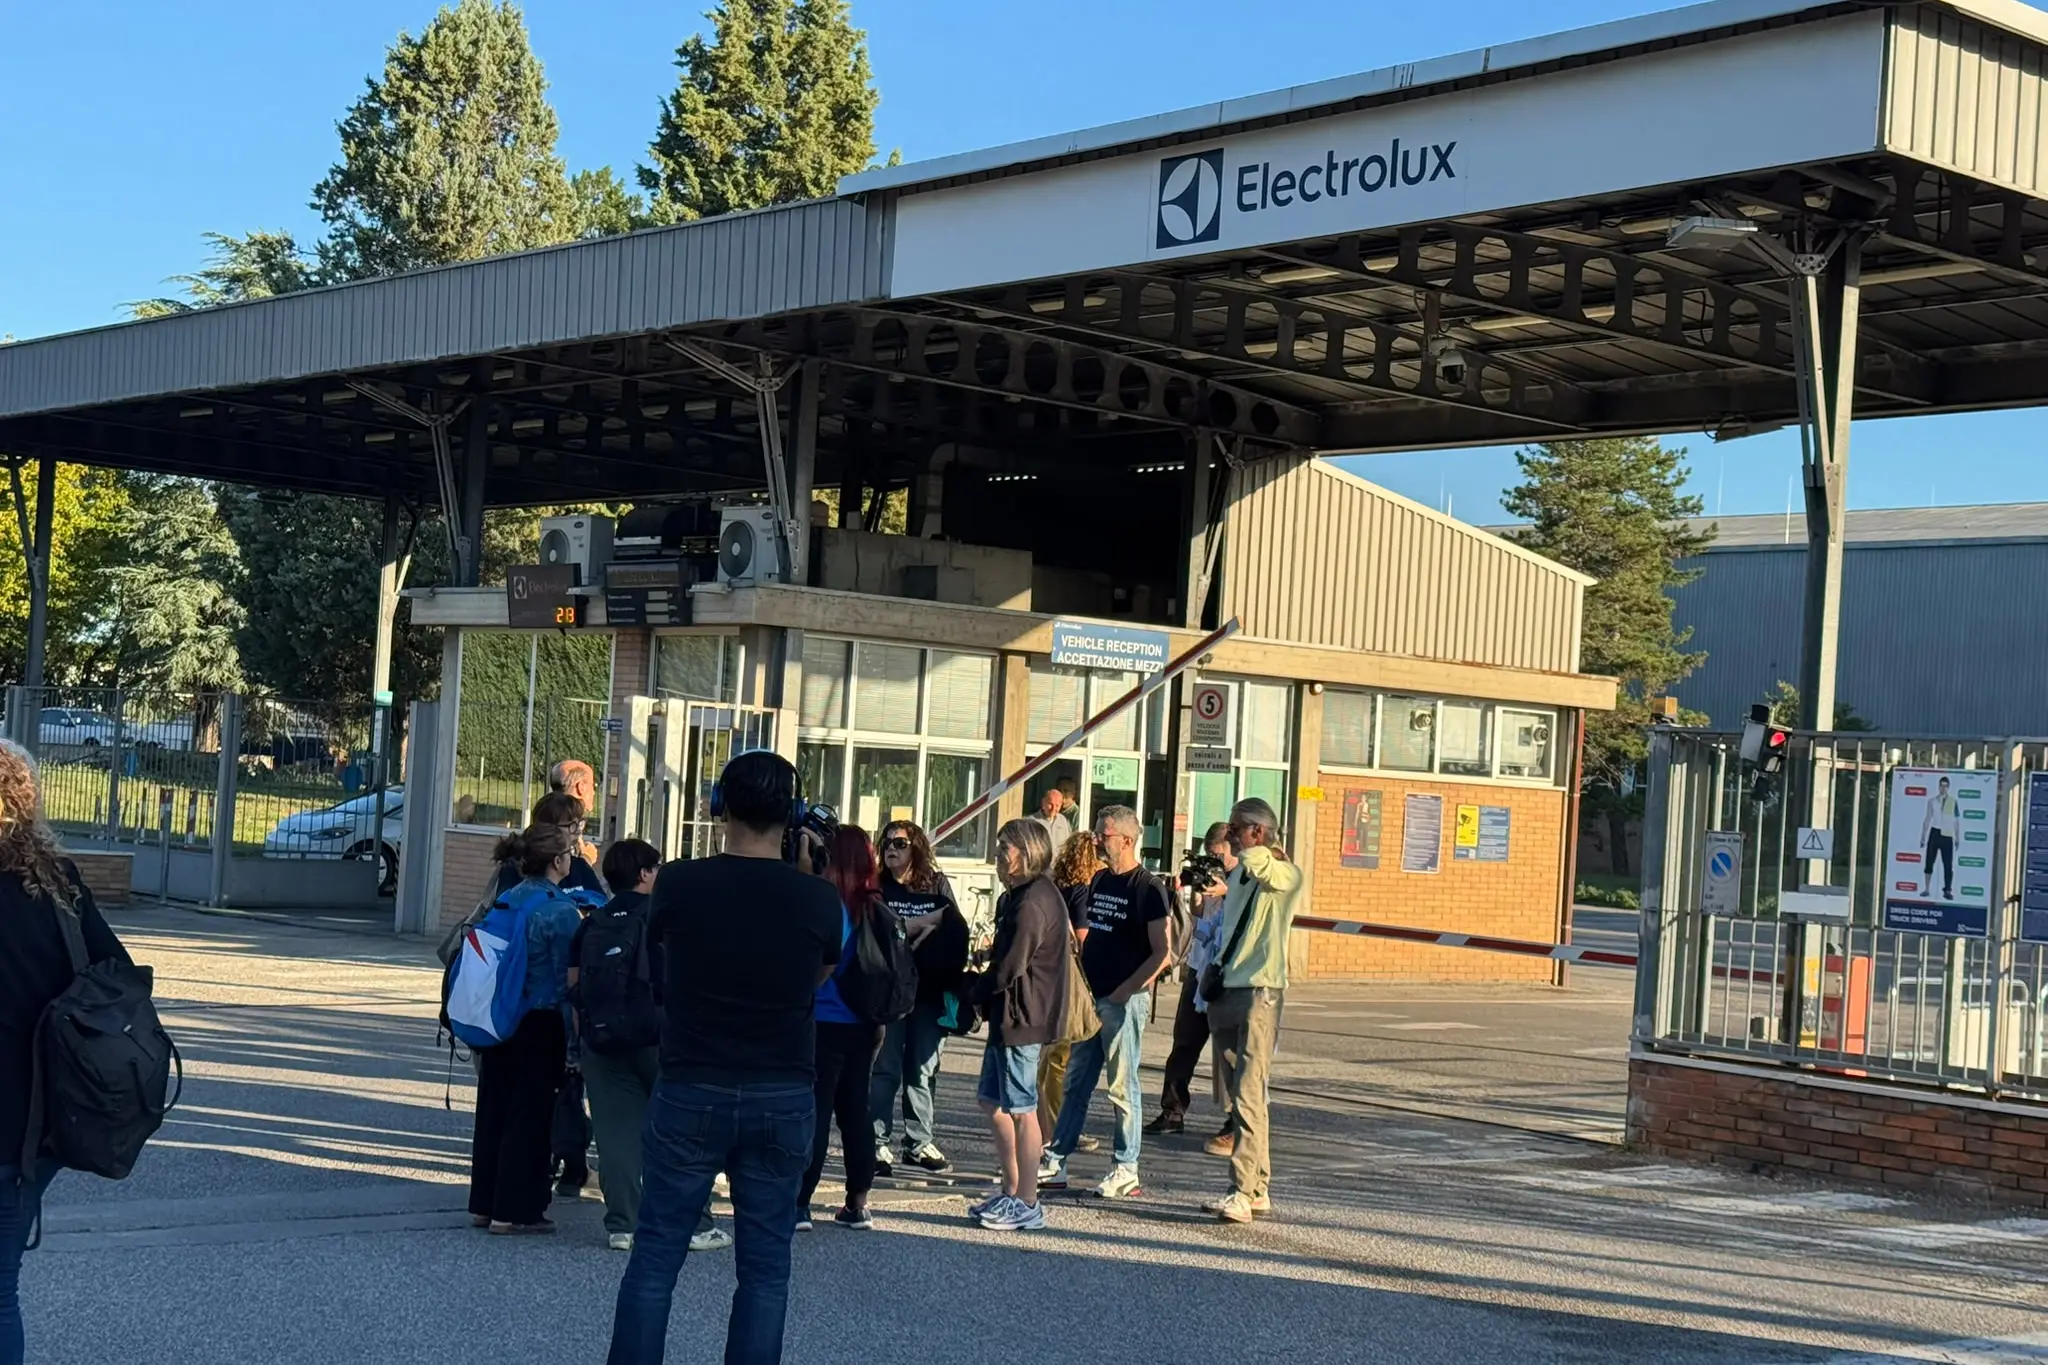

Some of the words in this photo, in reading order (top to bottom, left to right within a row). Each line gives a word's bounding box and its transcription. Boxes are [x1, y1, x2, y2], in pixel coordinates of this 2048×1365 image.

[1236, 138, 1458, 213] Electrolux
[1061, 634, 1105, 650] VEHICLE
[1106, 640, 1163, 656] RECEPTION
[1057, 651, 1133, 670] ACCETTAZIONE
[1205, 695, 1215, 714] 5
[1114, 912, 1127, 920] PIÙ
[1889, 915, 1910, 923] TRUCK
[1911, 916, 1938, 925] DRIVERS
[1911, 908, 1928, 916] CODE
[1929, 909, 1943, 918] FOR
